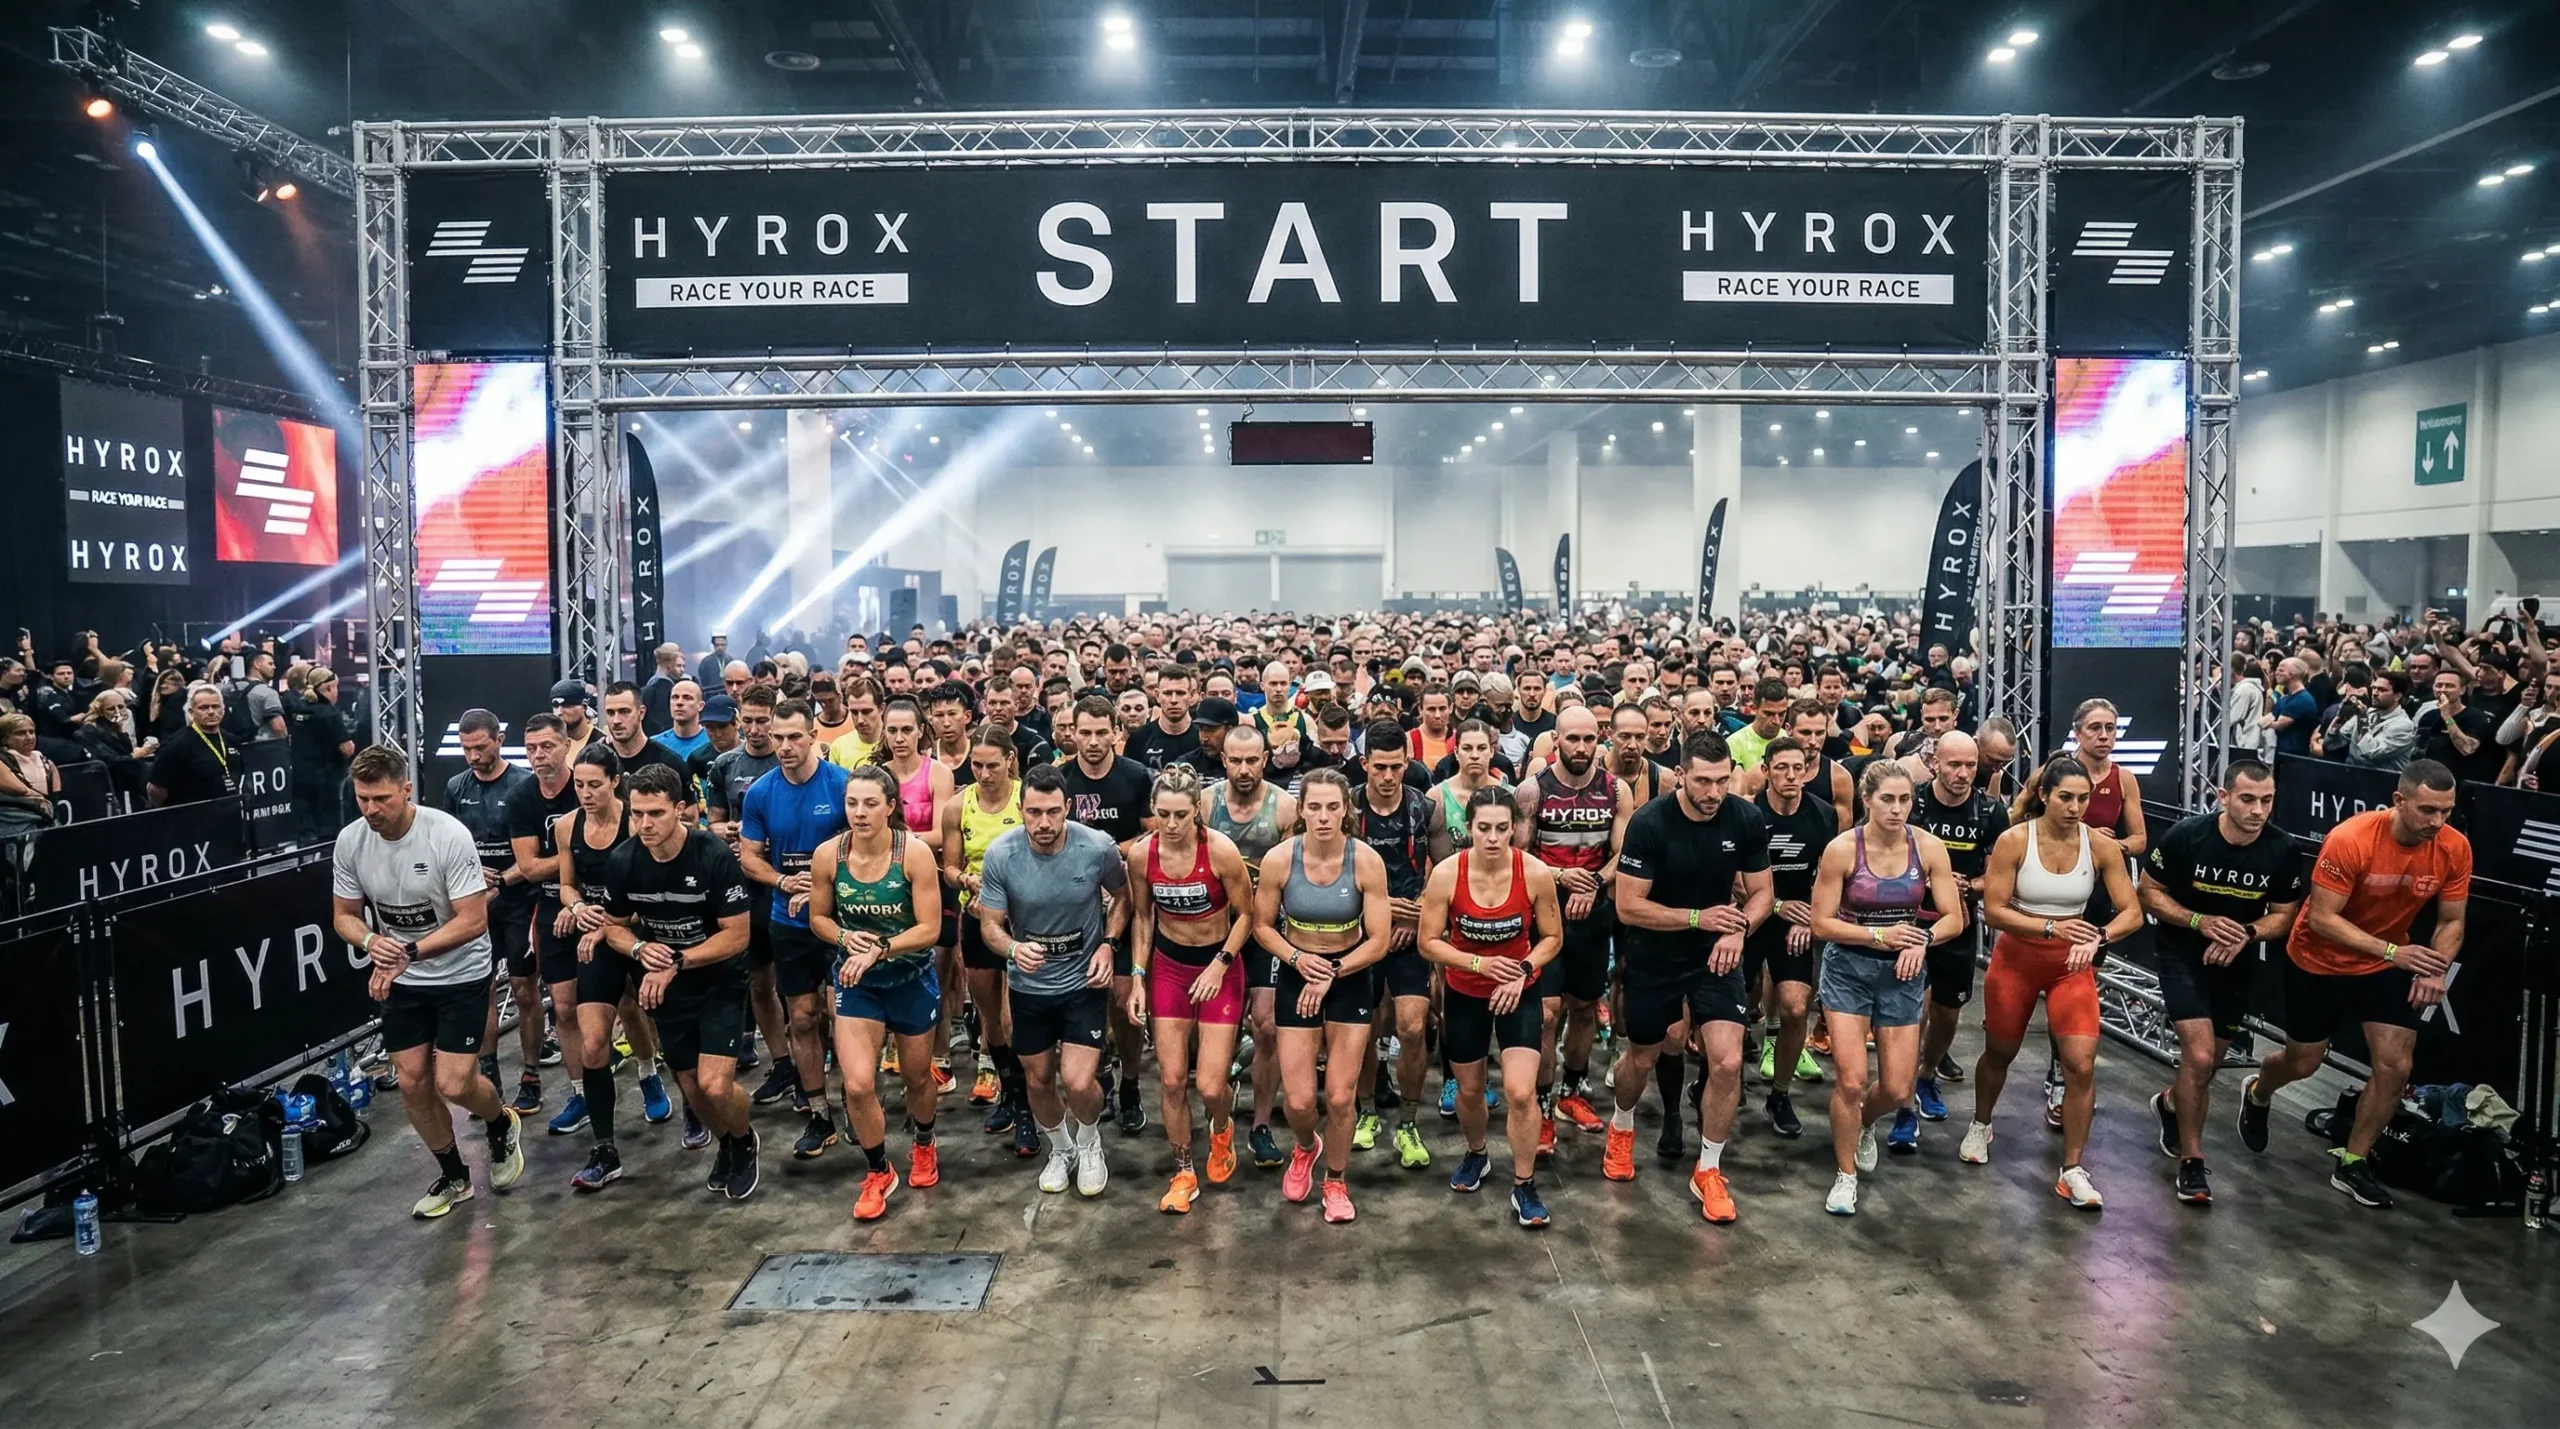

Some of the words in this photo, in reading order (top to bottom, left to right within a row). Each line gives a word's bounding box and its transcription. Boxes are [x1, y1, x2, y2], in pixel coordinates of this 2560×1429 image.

[634, 213, 909, 259] HYROX
[1036, 201, 1568, 306] START
[1682, 210, 1955, 255] HYROX
[670, 282, 732, 302] RACE
[739, 281, 804, 300] YOUR
[813, 279, 875, 299] RACE
[1718, 277, 1779, 296] RACE
[1786, 278, 1850, 297] YOUR
[1859, 279, 1920, 298] RACE
[67, 434, 184, 477] HYROX
[91, 489, 117, 505] RACE
[71, 539, 187, 572] HYROX
[636, 496, 656, 641] HYROX
[1935, 501, 1972, 631] HYROX
[1004, 557, 1022, 622] HYROX
[79, 841, 212, 900] HYROX
[2194, 863, 2271, 888] HYROX
